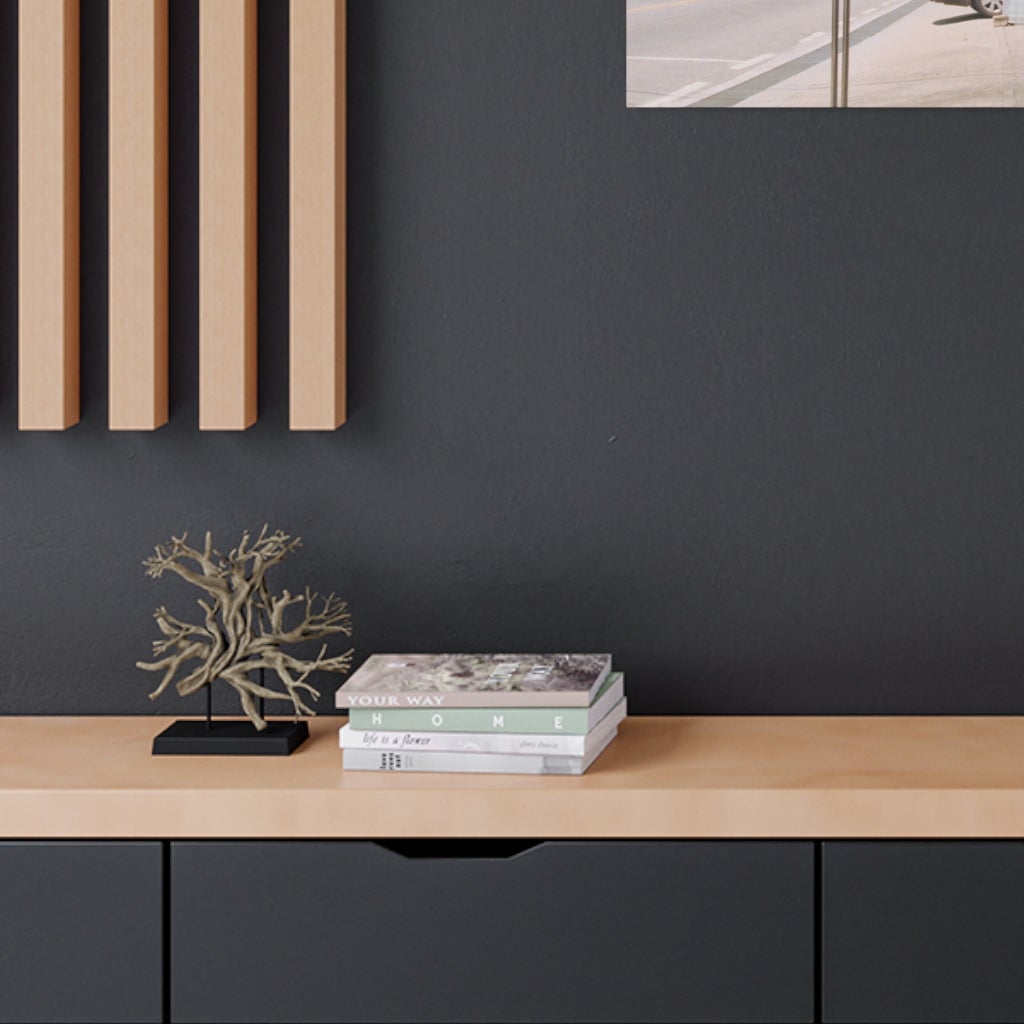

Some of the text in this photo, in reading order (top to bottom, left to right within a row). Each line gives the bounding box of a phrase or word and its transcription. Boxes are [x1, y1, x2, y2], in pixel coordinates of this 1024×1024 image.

[348, 695, 444, 706] YOUR WAY
[362, 732, 378, 747] life
[400, 733, 431, 748] flower
